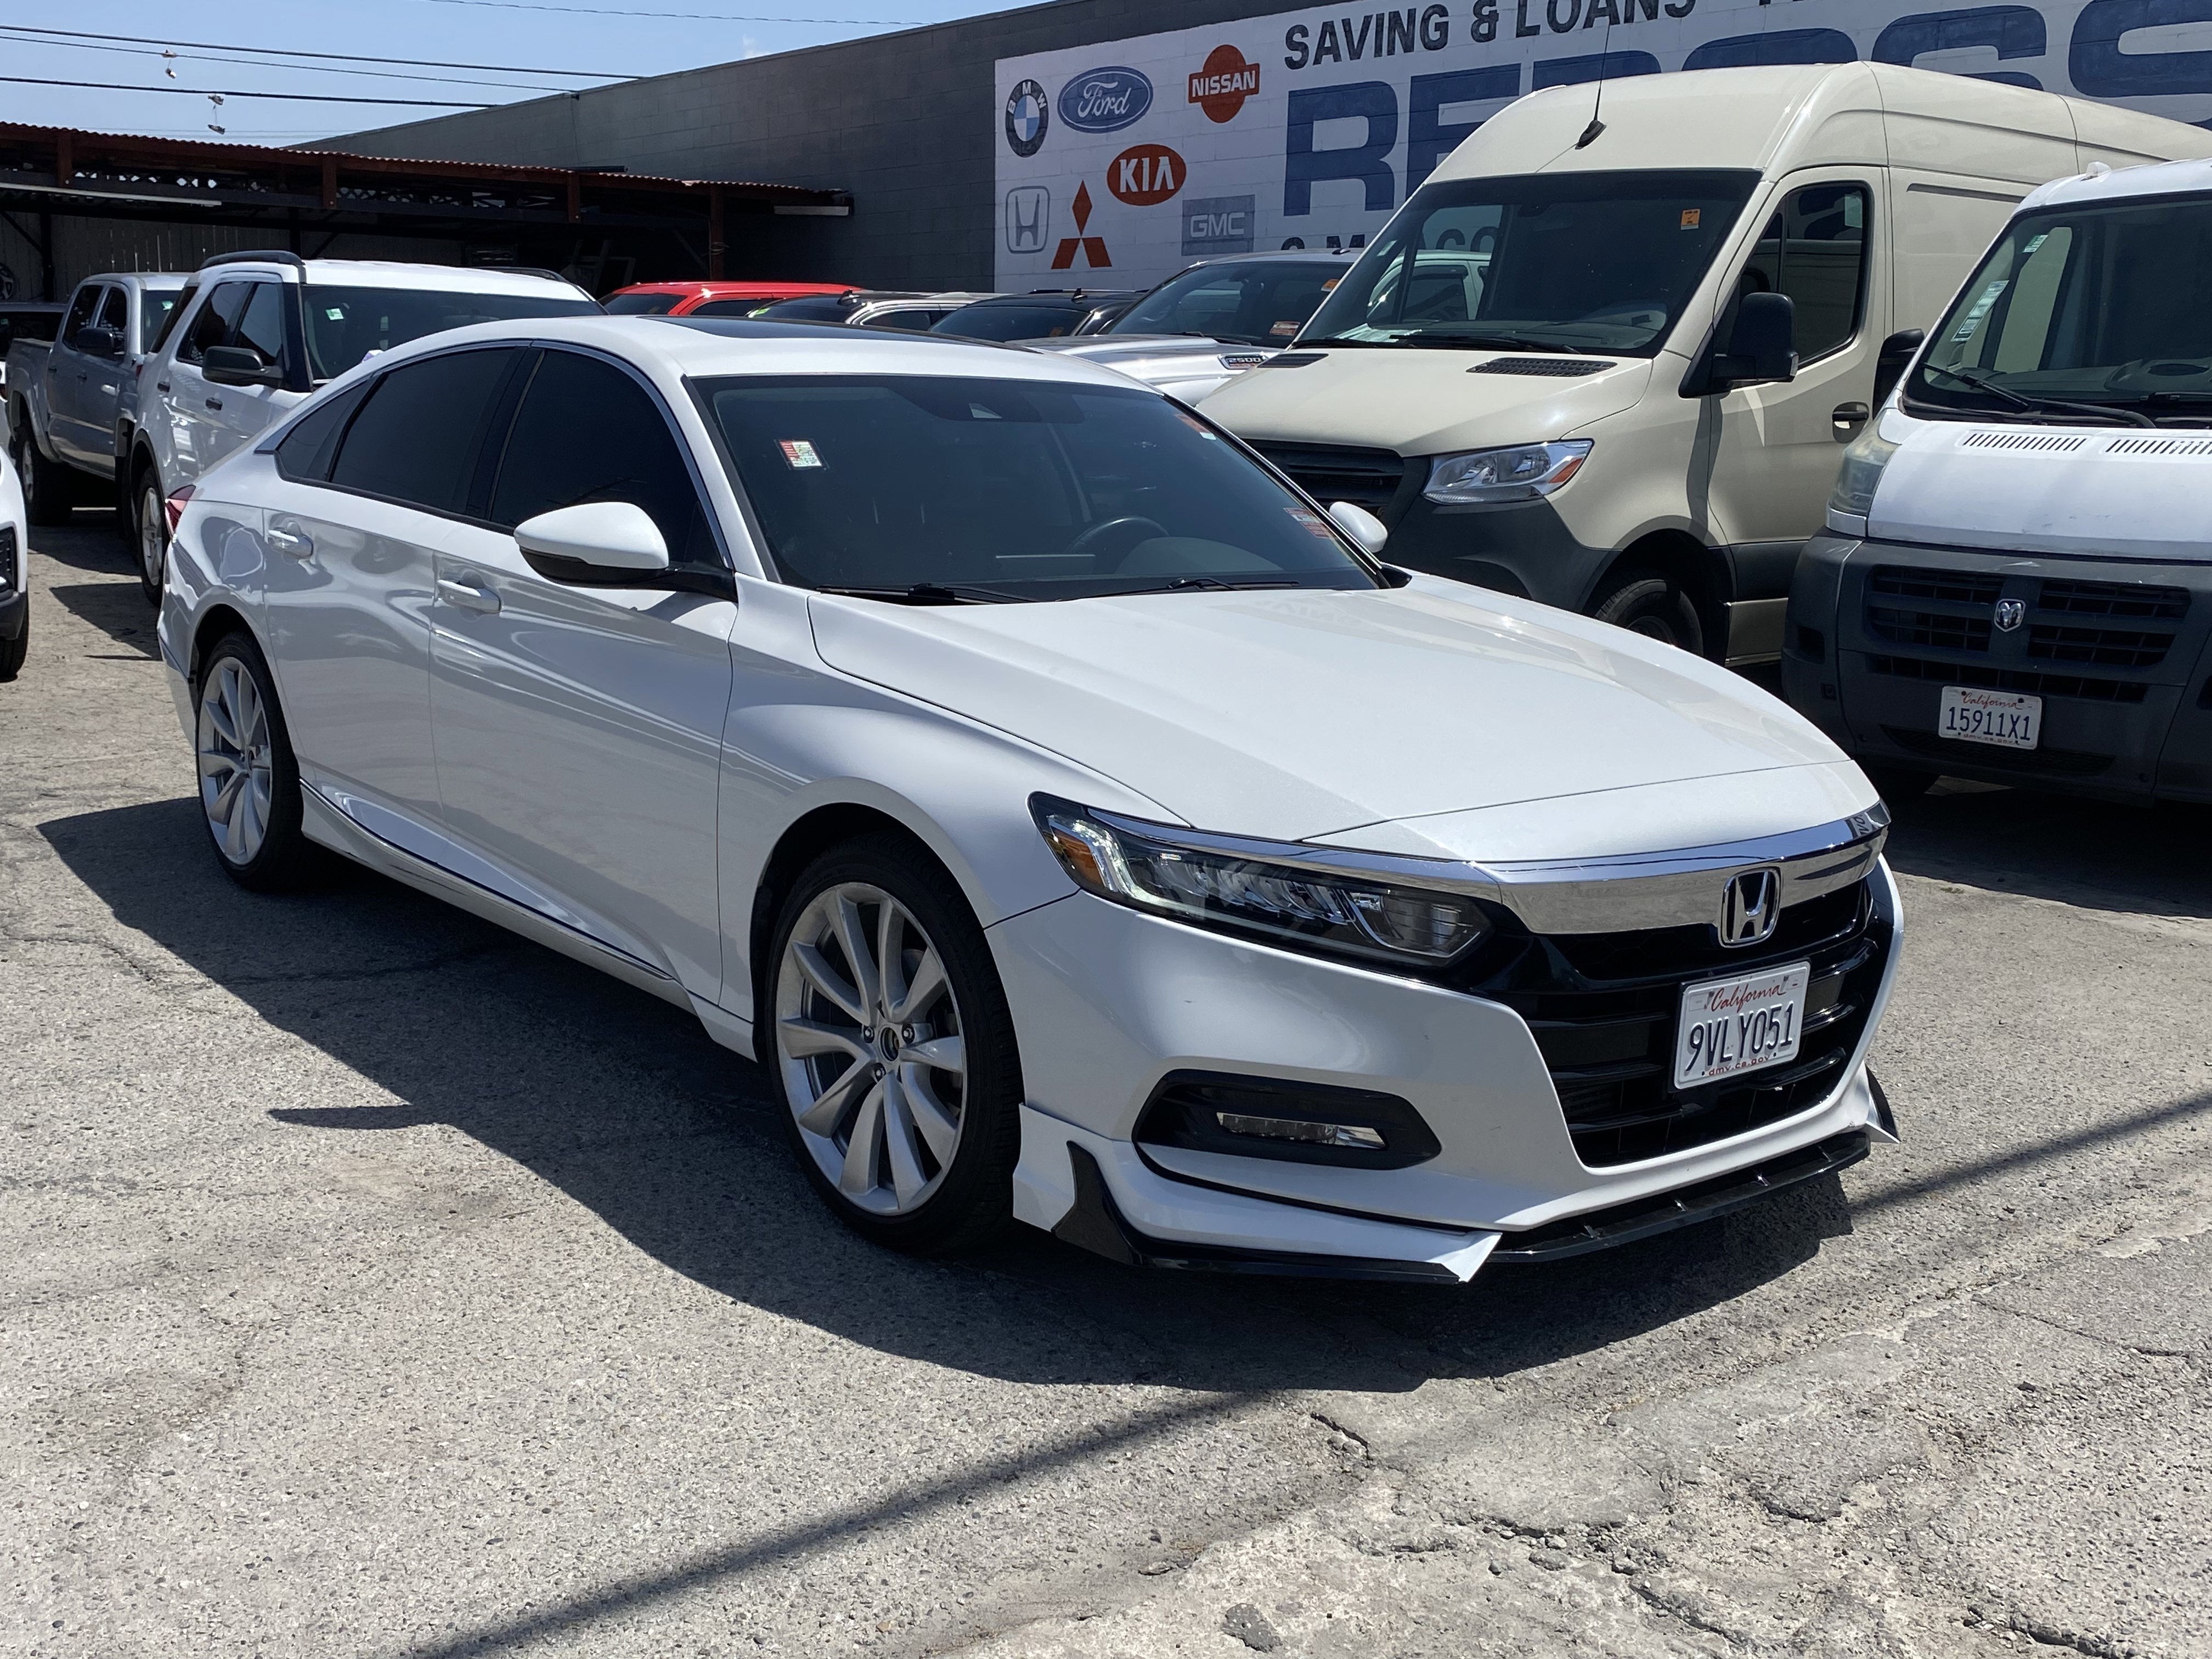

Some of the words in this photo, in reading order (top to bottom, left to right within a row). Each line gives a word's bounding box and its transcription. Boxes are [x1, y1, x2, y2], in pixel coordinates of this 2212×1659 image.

[1285, 4, 1449, 70] SAVING
[1471, 0, 1499, 42] &
[1007, 81, 1047, 113] BMW
[1077, 81, 1130, 117] Ford
[1192, 71, 1256, 97] NISSAN
[1119, 156, 1174, 193] KIA
[1189, 212, 1245, 238] GMC
[1963, 692, 2023, 710] California
[1946, 706, 2030, 741] 15911X1
[1711, 983, 1787, 1013] California
[1685, 1001, 1793, 1072] 9VLY051
[1708, 1054, 1770, 1077] dmv.ca.gov
